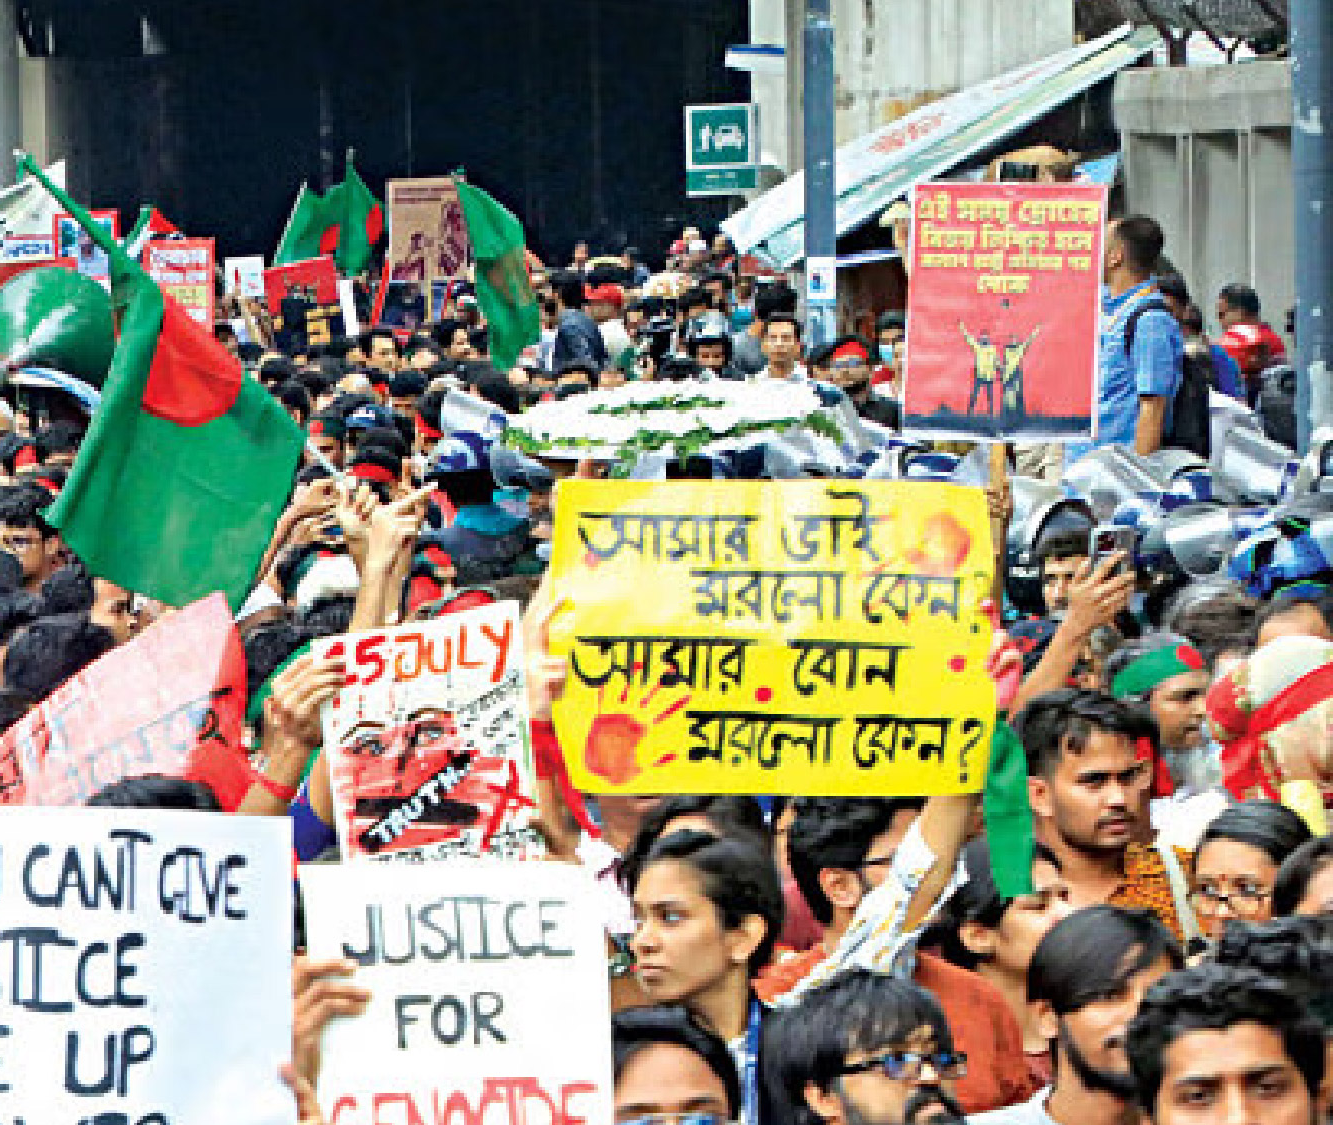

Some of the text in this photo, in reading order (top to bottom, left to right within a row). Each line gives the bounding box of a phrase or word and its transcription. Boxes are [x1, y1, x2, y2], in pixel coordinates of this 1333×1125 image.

[577, 488, 881, 563] আমার ভাই
[690, 569, 845, 624] মরলো
[394, 619, 515, 684] JULY
[571, 635, 913, 696] আমার বোন
[685, 710, 844, 770] মরলো
[158, 846, 247, 924] GIVE
[342, 895, 574, 967] JUSTICE
[394, 991, 508, 1050] FOR
[63, 1024, 155, 1098] UP
